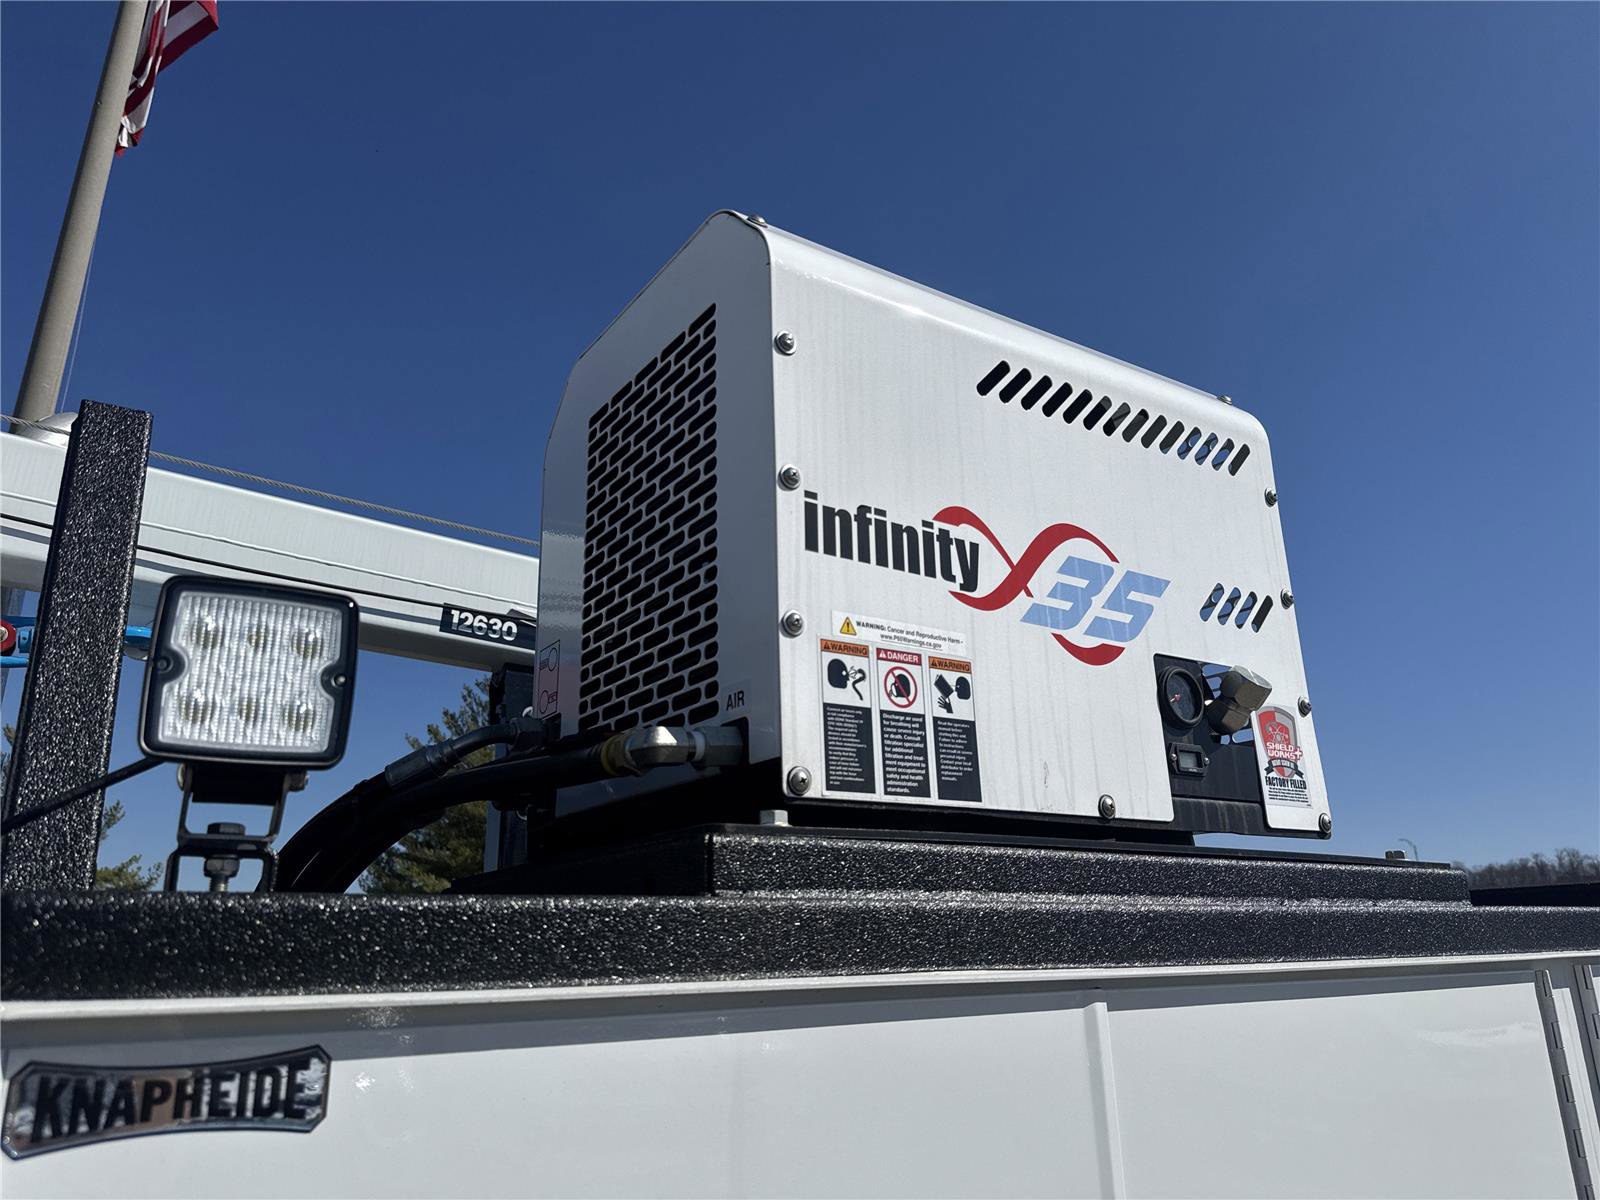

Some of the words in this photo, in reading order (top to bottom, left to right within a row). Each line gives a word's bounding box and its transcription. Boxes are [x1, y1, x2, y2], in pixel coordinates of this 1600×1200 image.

[804, 489, 980, 593] infinity
[1020, 555, 1171, 643] 35
[451, 609, 518, 641] 12630
[855, 621, 886, 631] WARNING:
[887, 626, 904, 635] Cancer
[905, 628, 915, 636] and
[916, 630, 947, 642] Reproductive
[831, 642, 867, 656] WARNING
[887, 650, 918, 663] DANGER
[937, 661, 970, 672] WARNING
[726, 690, 745, 711] AIR
[1266, 741, 1294, 752] SHIELD
[1265, 776, 1289, 788] FACTORY
[1290, 778, 1307, 790] FILLED
[31, 1057, 312, 1142] KNAPHEIDE
